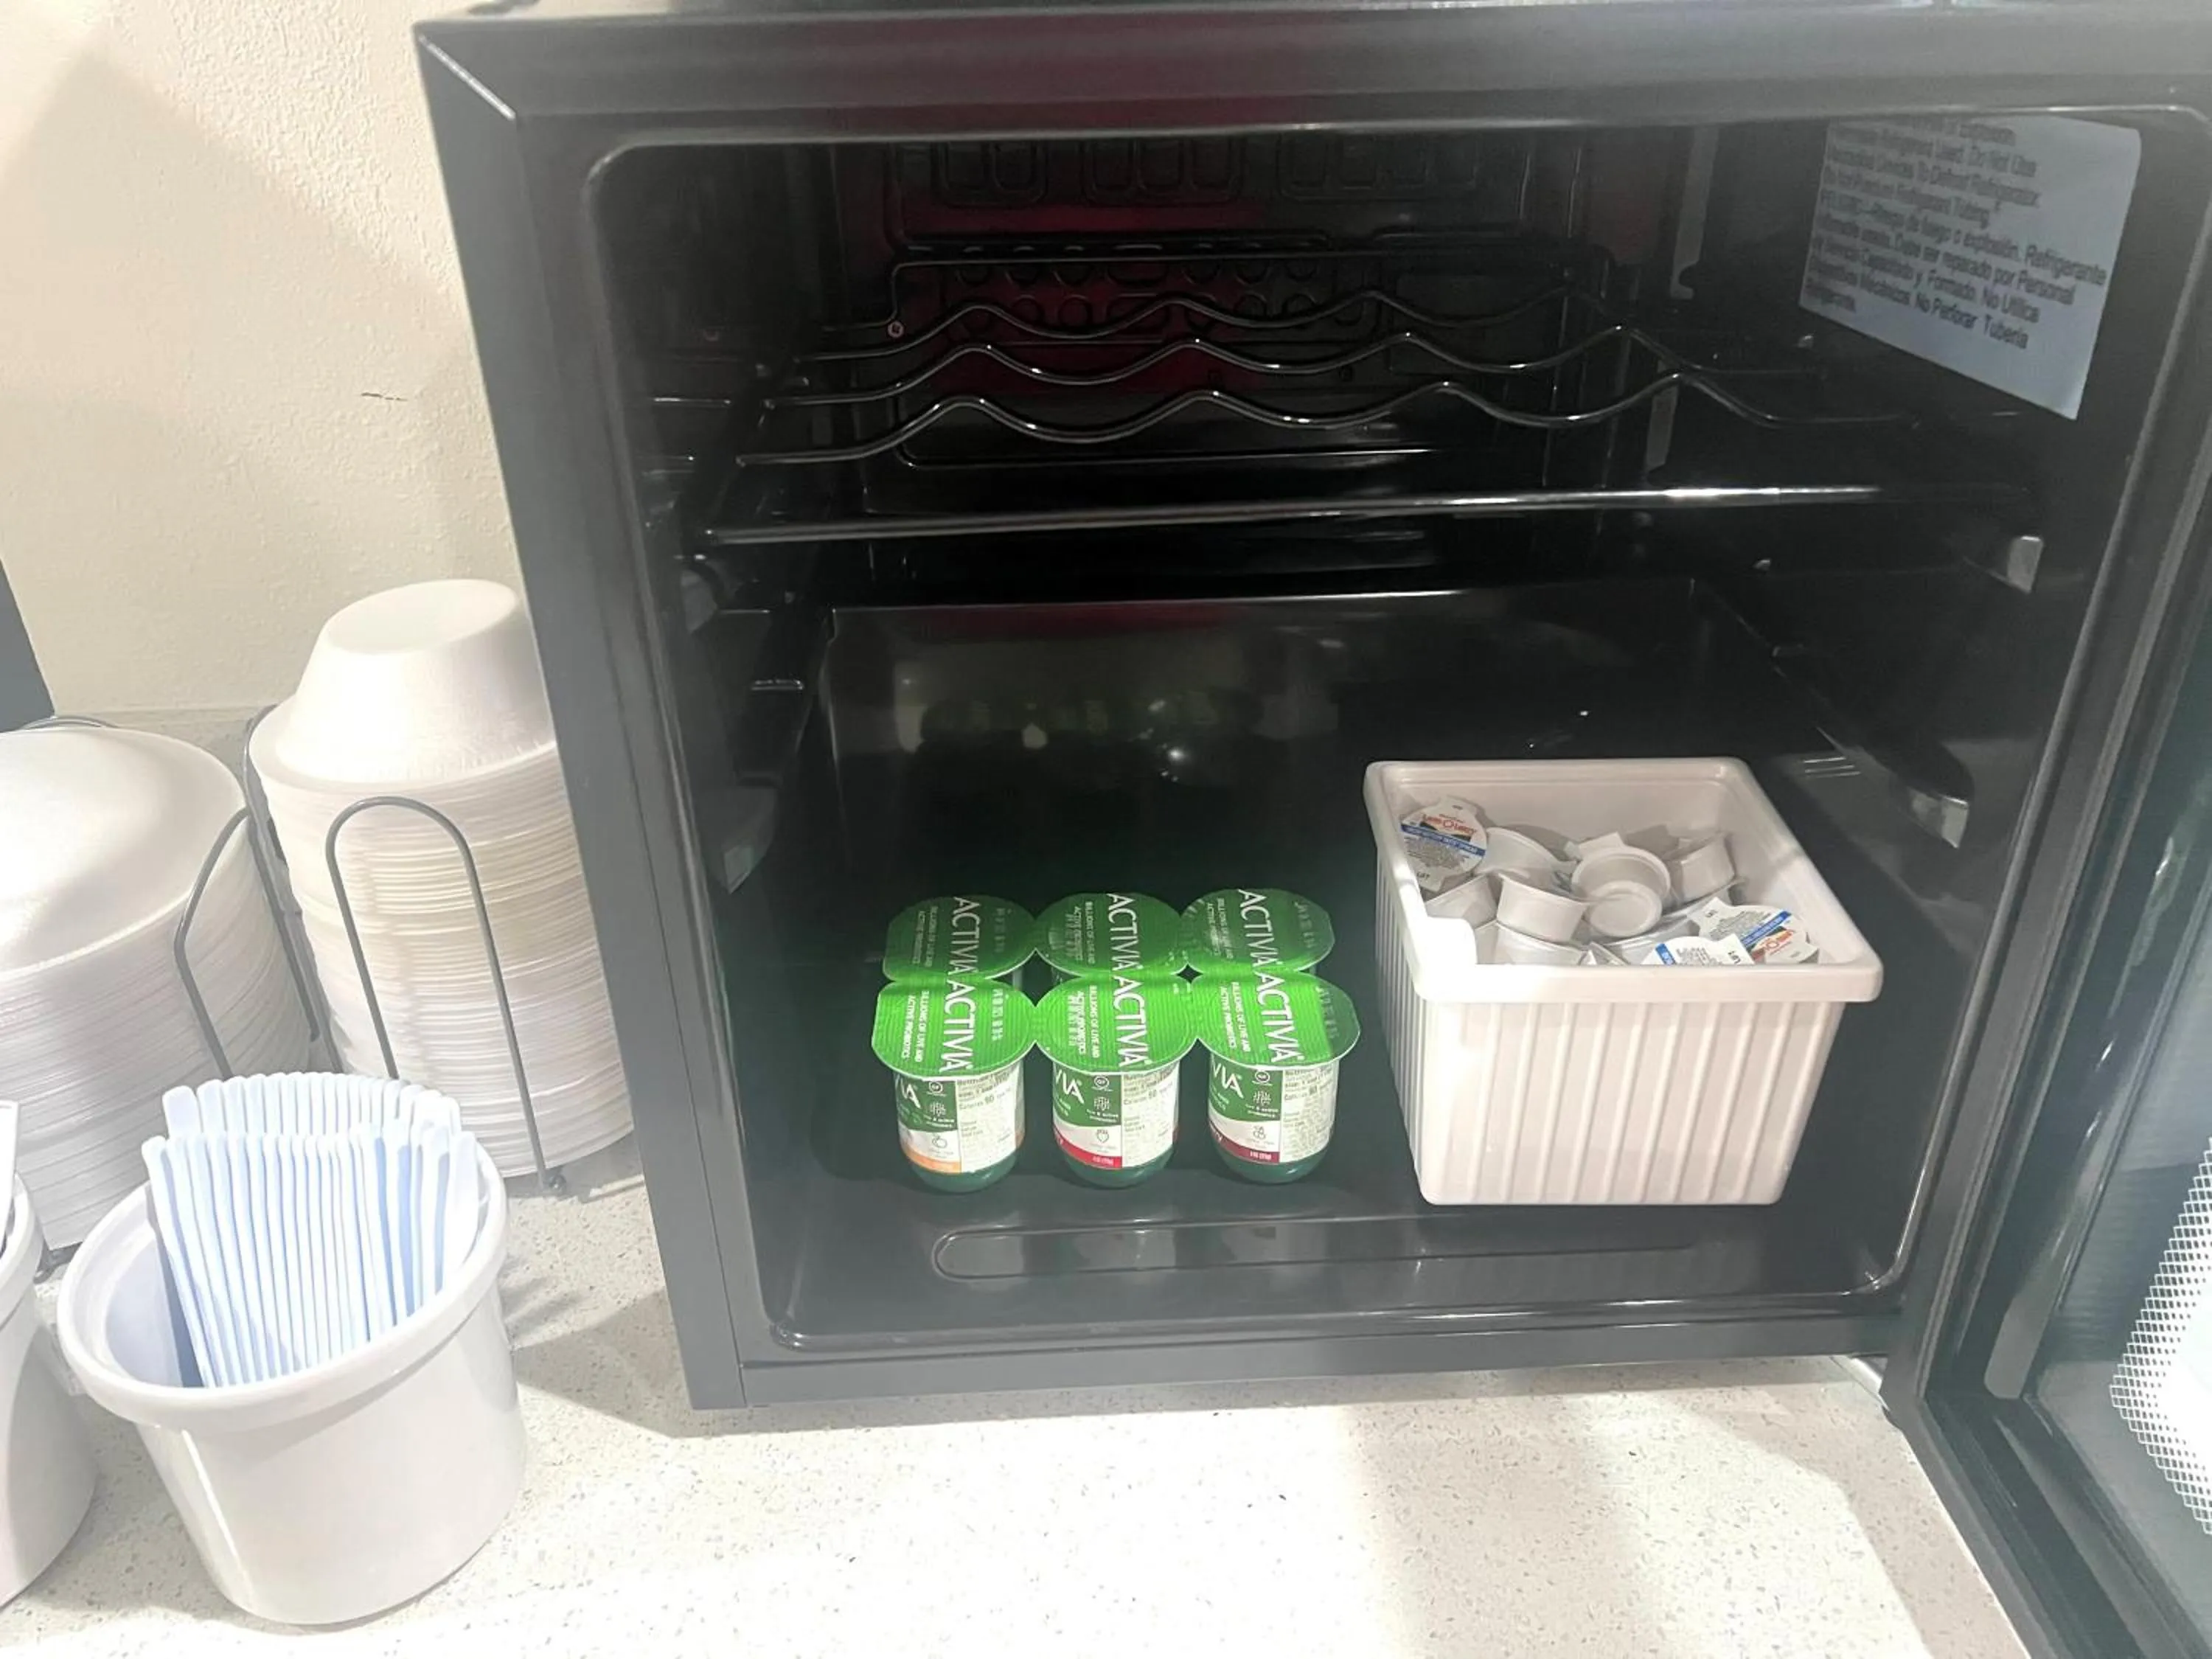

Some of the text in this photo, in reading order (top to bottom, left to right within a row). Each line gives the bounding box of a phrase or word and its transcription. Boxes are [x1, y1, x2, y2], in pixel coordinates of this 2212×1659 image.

[947, 896, 981, 975] ACTIVIA
[1107, 893, 1141, 971] ACTIVIA
[1238, 889, 1280, 967] ACTIVIA
[939, 979, 975, 1073] ACTIVIA
[1113, 975, 1150, 1067] ACTIVIA
[1254, 971, 1301, 1062] ACTIVIA
